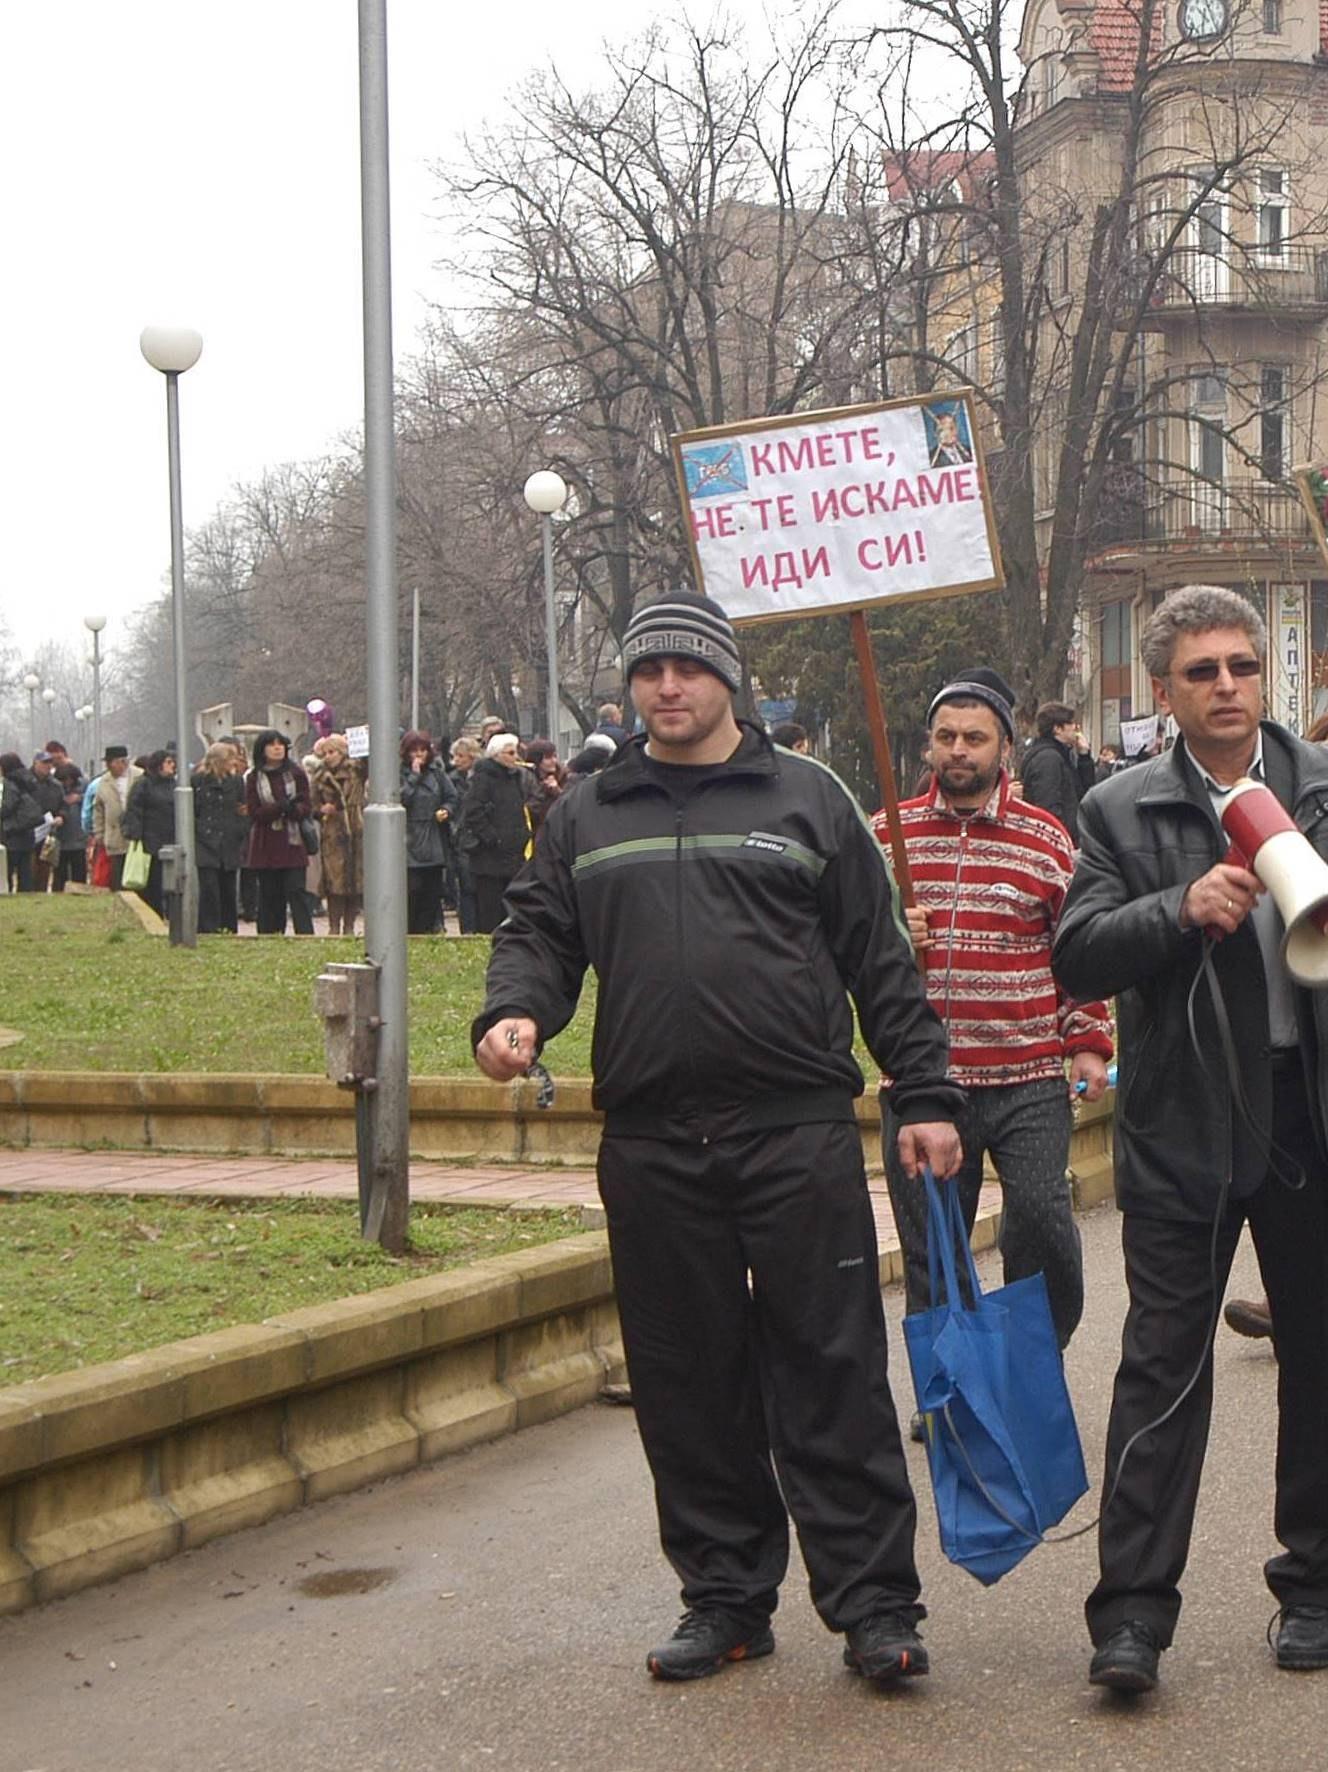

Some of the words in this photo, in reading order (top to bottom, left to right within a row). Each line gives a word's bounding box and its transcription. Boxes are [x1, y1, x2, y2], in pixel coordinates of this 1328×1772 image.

[751, 427, 896, 477] КМЕТЕ,
[751, 495, 797, 531] ТЕ
[740, 545, 831, 592] ИДИ
[857, 530, 927, 571] СИ!
[1287, 627, 1299, 734] АПТЕК
